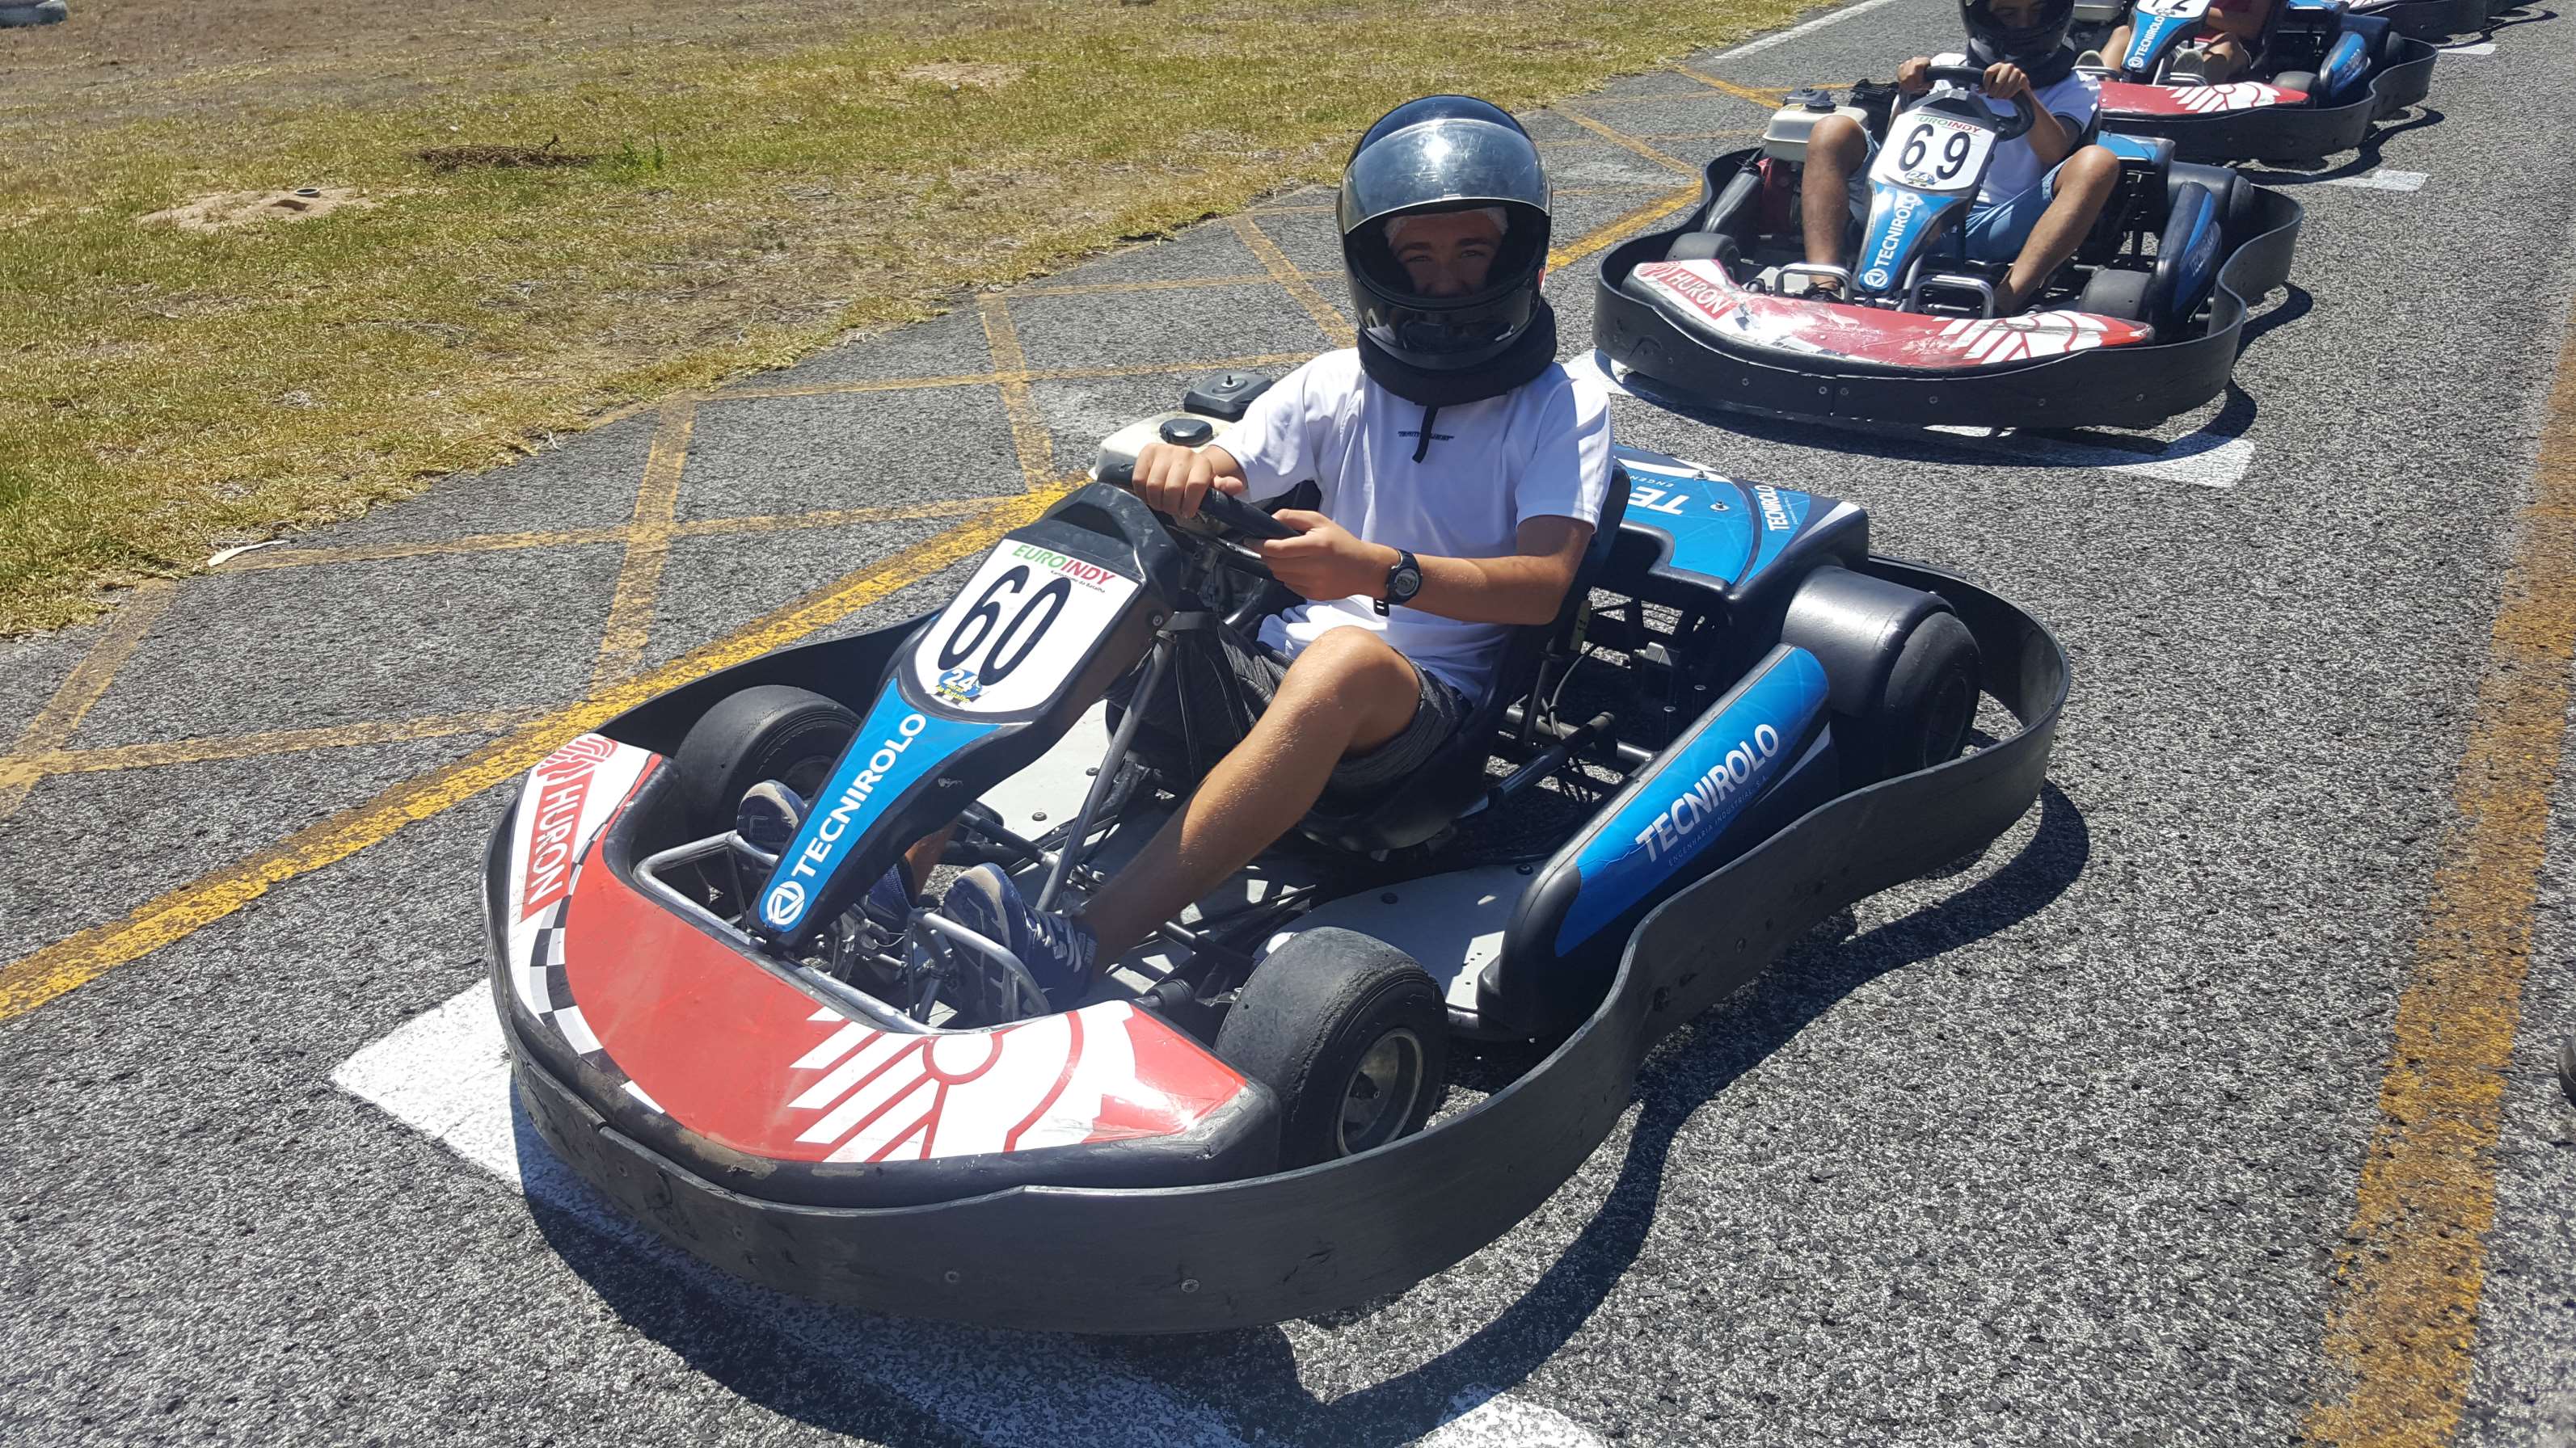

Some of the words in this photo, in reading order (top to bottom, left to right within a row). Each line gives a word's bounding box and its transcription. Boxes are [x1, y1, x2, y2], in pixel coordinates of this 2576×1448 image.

[2135, 16, 2165, 57] TECNIROLO
[1899, 124, 1971, 180] 69
[1874, 192, 1920, 267] TECNIROLO
[1667, 272, 1731, 314] HURON
[1754, 485, 1790, 531] TECNIROLO
[1012, 545, 1119, 586] EUROINDY
[938, 565, 1072, 687] 60
[942, 668, 978, 692] 24
[791, 713, 927, 878] TECNIROLO
[1634, 724, 1779, 863] TECNIROLO
[529, 784, 584, 905] HURON
